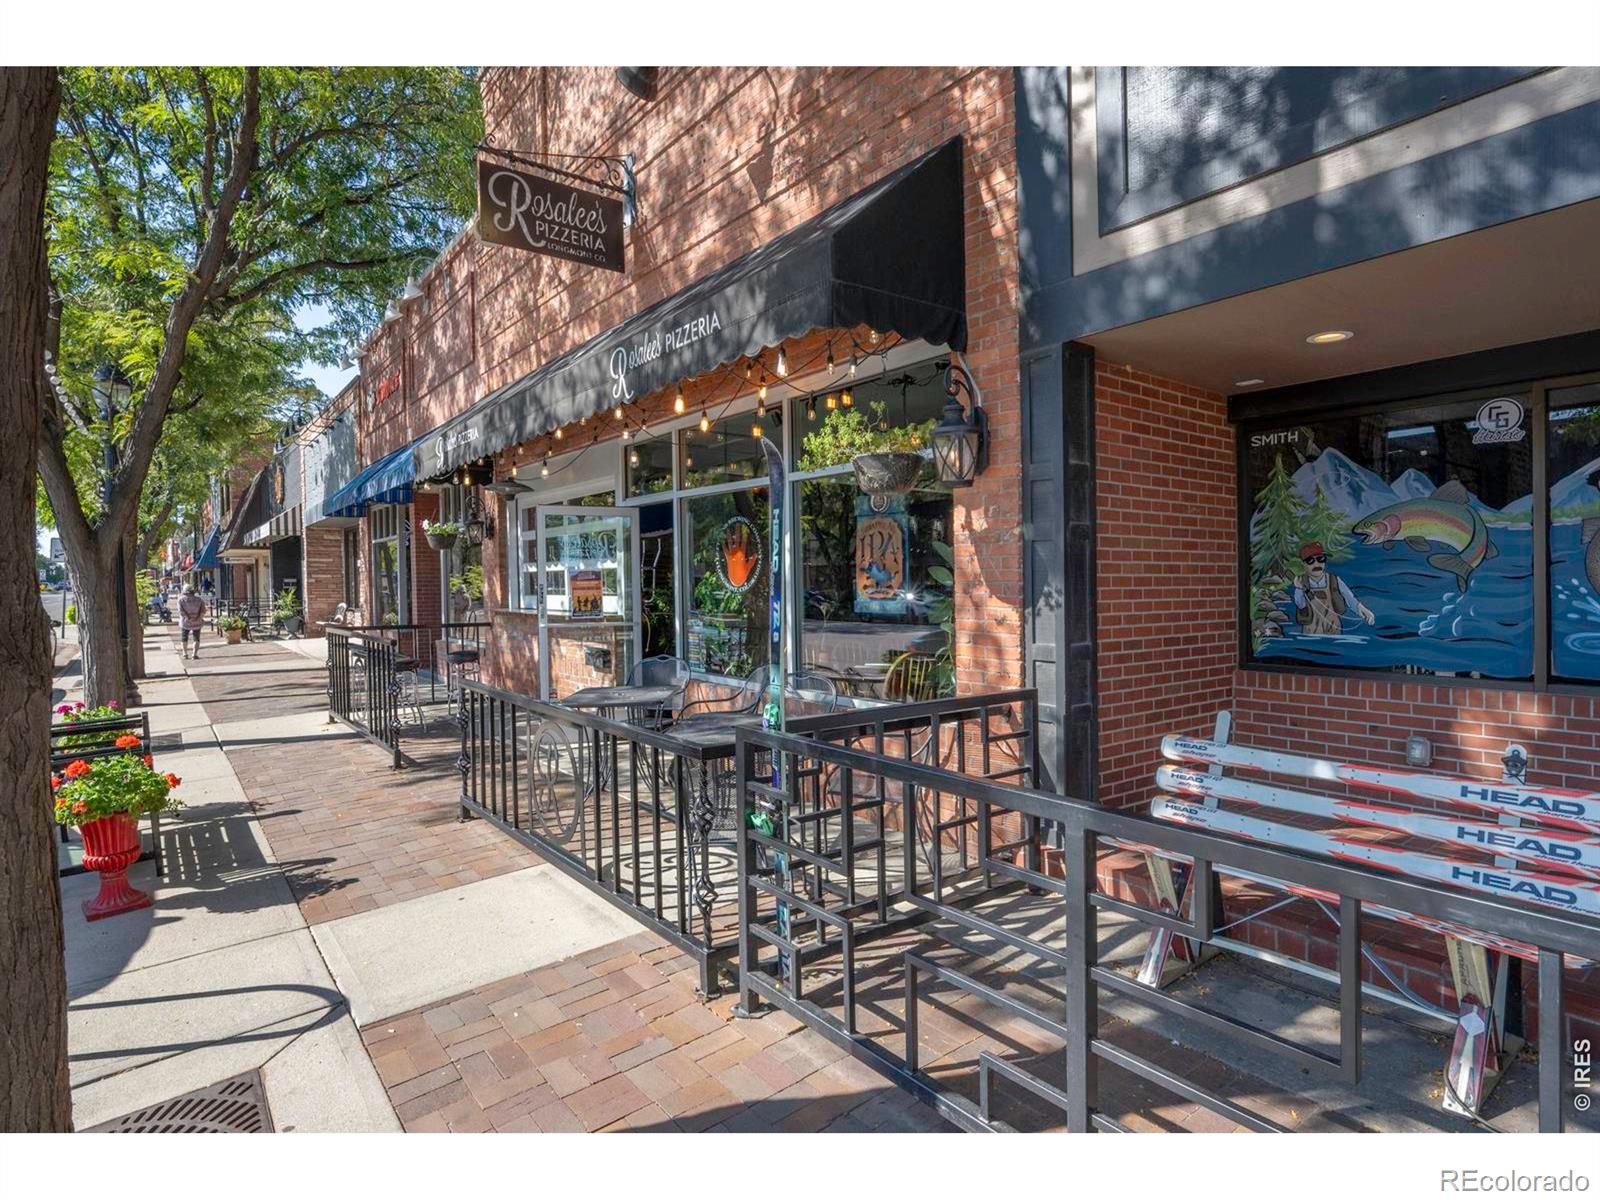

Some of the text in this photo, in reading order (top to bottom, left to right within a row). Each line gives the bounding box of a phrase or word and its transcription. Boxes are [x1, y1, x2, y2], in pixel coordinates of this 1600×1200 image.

[488, 171, 608, 248] Rosalee's
[535, 220, 607, 252] PIZZERIA
[610, 310, 721, 399] Rosalee's PIZZERIA
[1250, 430, 1298, 447] SMITH
[772, 508, 780, 573] HEAD
[1174, 741, 1208, 751] HEAD
[1170, 772, 1204, 784] HEAD
[1165, 803, 1199, 815] HEAD
[1460, 785, 1585, 816] HEAD
[1457, 826, 1582, 861] HEAD
[1452, 866, 1578, 905] HEAD
